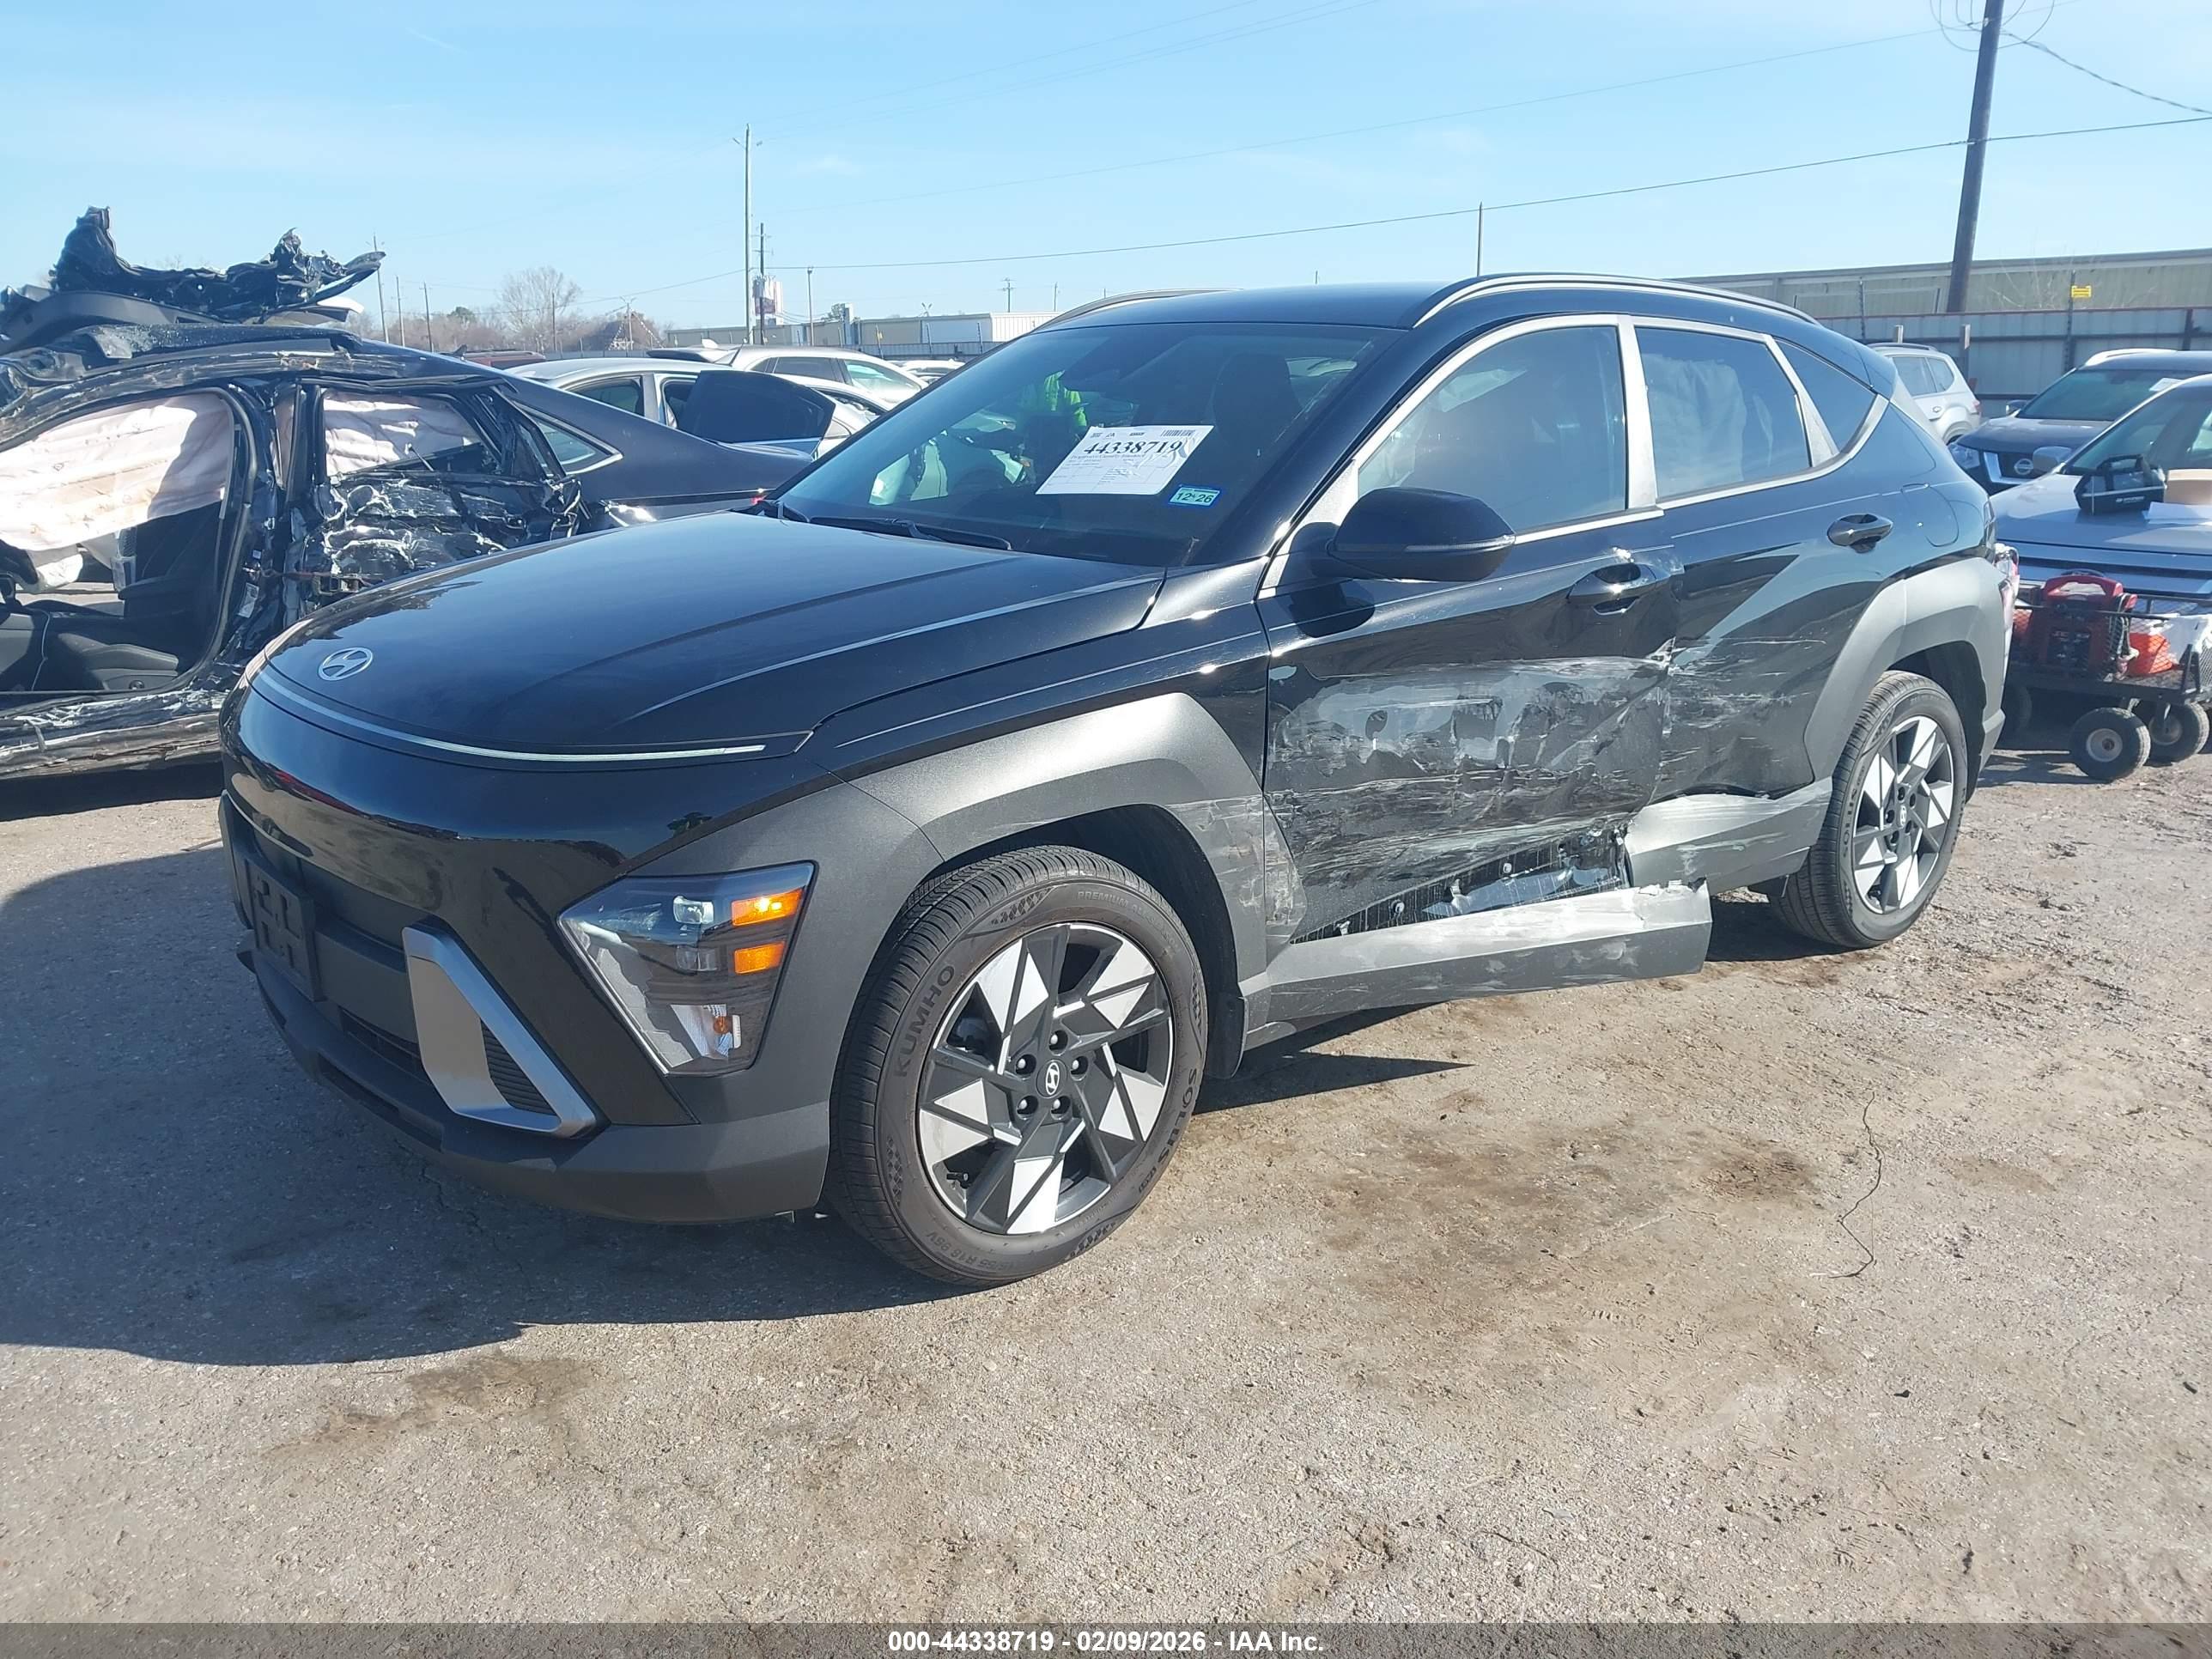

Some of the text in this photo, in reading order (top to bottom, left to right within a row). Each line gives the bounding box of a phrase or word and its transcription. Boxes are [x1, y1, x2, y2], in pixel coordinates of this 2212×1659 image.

[1085, 441, 1182, 454] 44338719
[1176, 492, 1214, 503] 12 26
[1077, 890, 1129, 908] PREMIUM
[894, 965, 955, 1077] KUMHO
[1158, 1068, 1197, 1163] SOLUS
